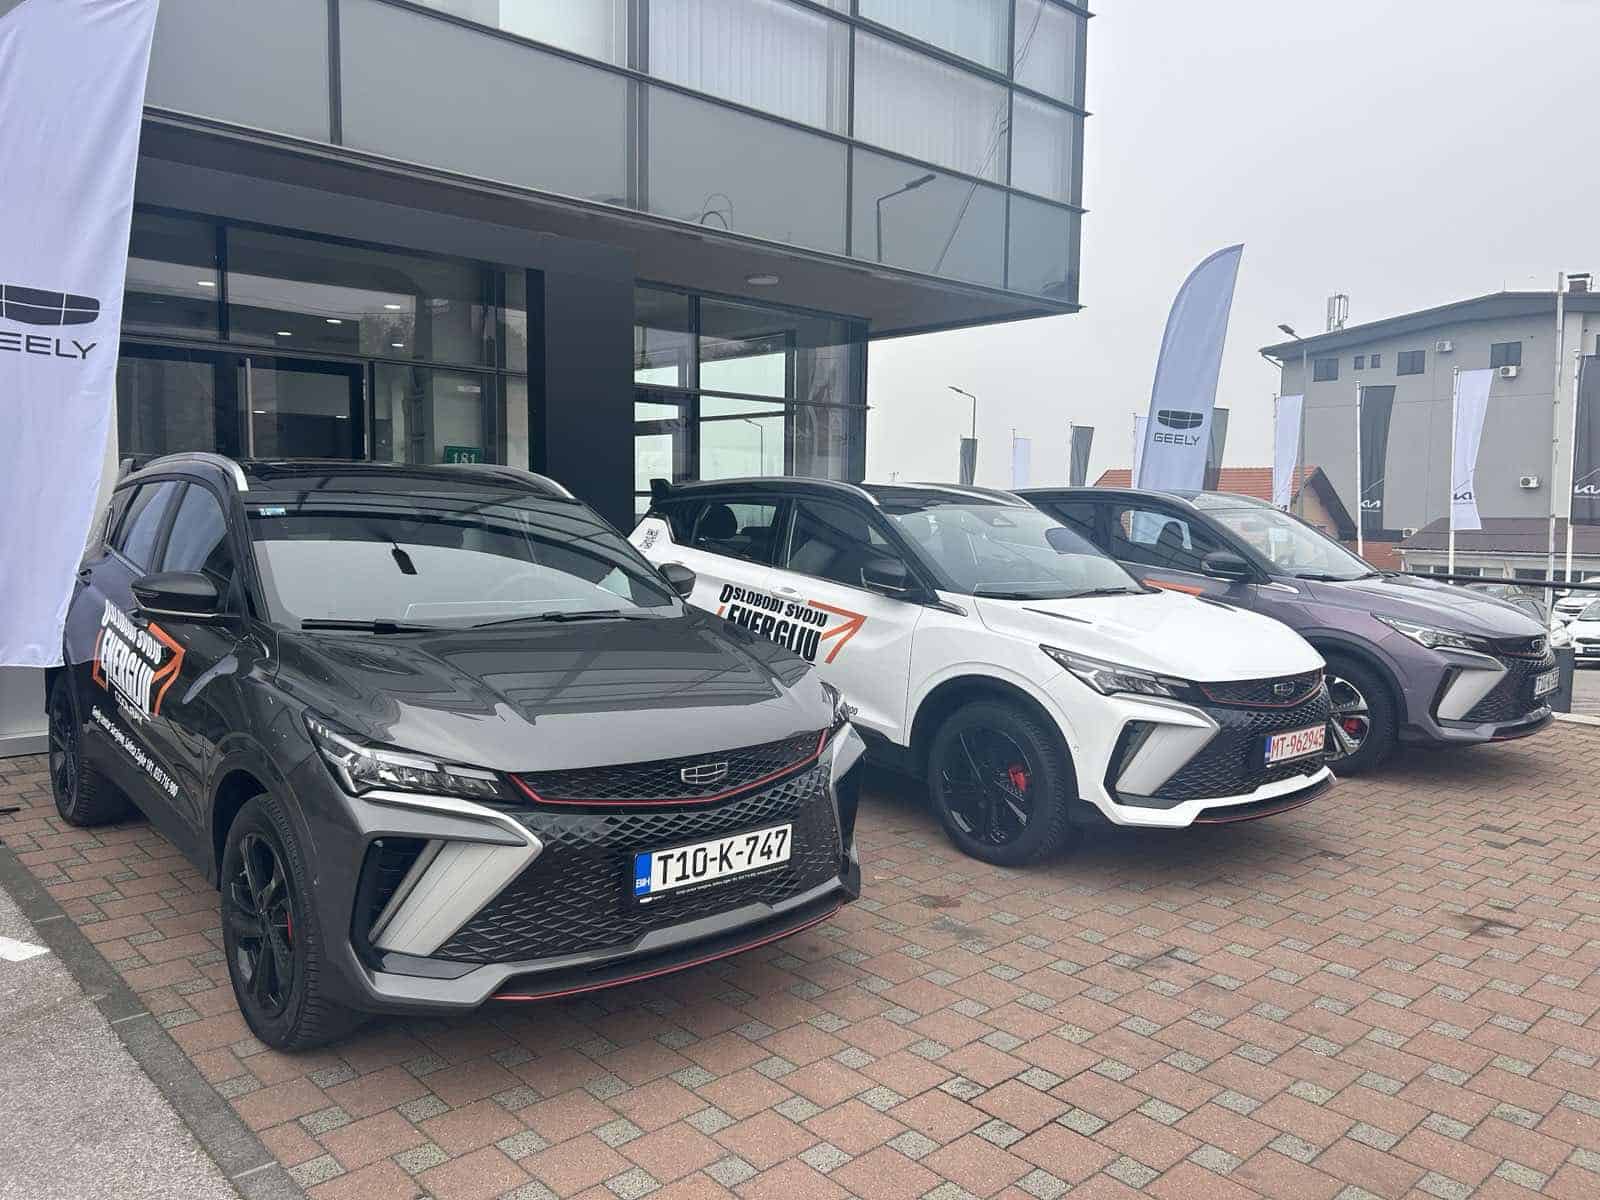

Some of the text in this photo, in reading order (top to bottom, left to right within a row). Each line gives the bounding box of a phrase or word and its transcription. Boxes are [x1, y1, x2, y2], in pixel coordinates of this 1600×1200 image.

[0, 331, 97, 360] EELY
[1153, 432, 1201, 446] GEELY
[719, 583, 829, 627] OSLOBODI SVOJU
[136, 629, 162, 665] SVOJU
[100, 627, 155, 715] ENERGIJU
[657, 828, 788, 885] T10-K-747
